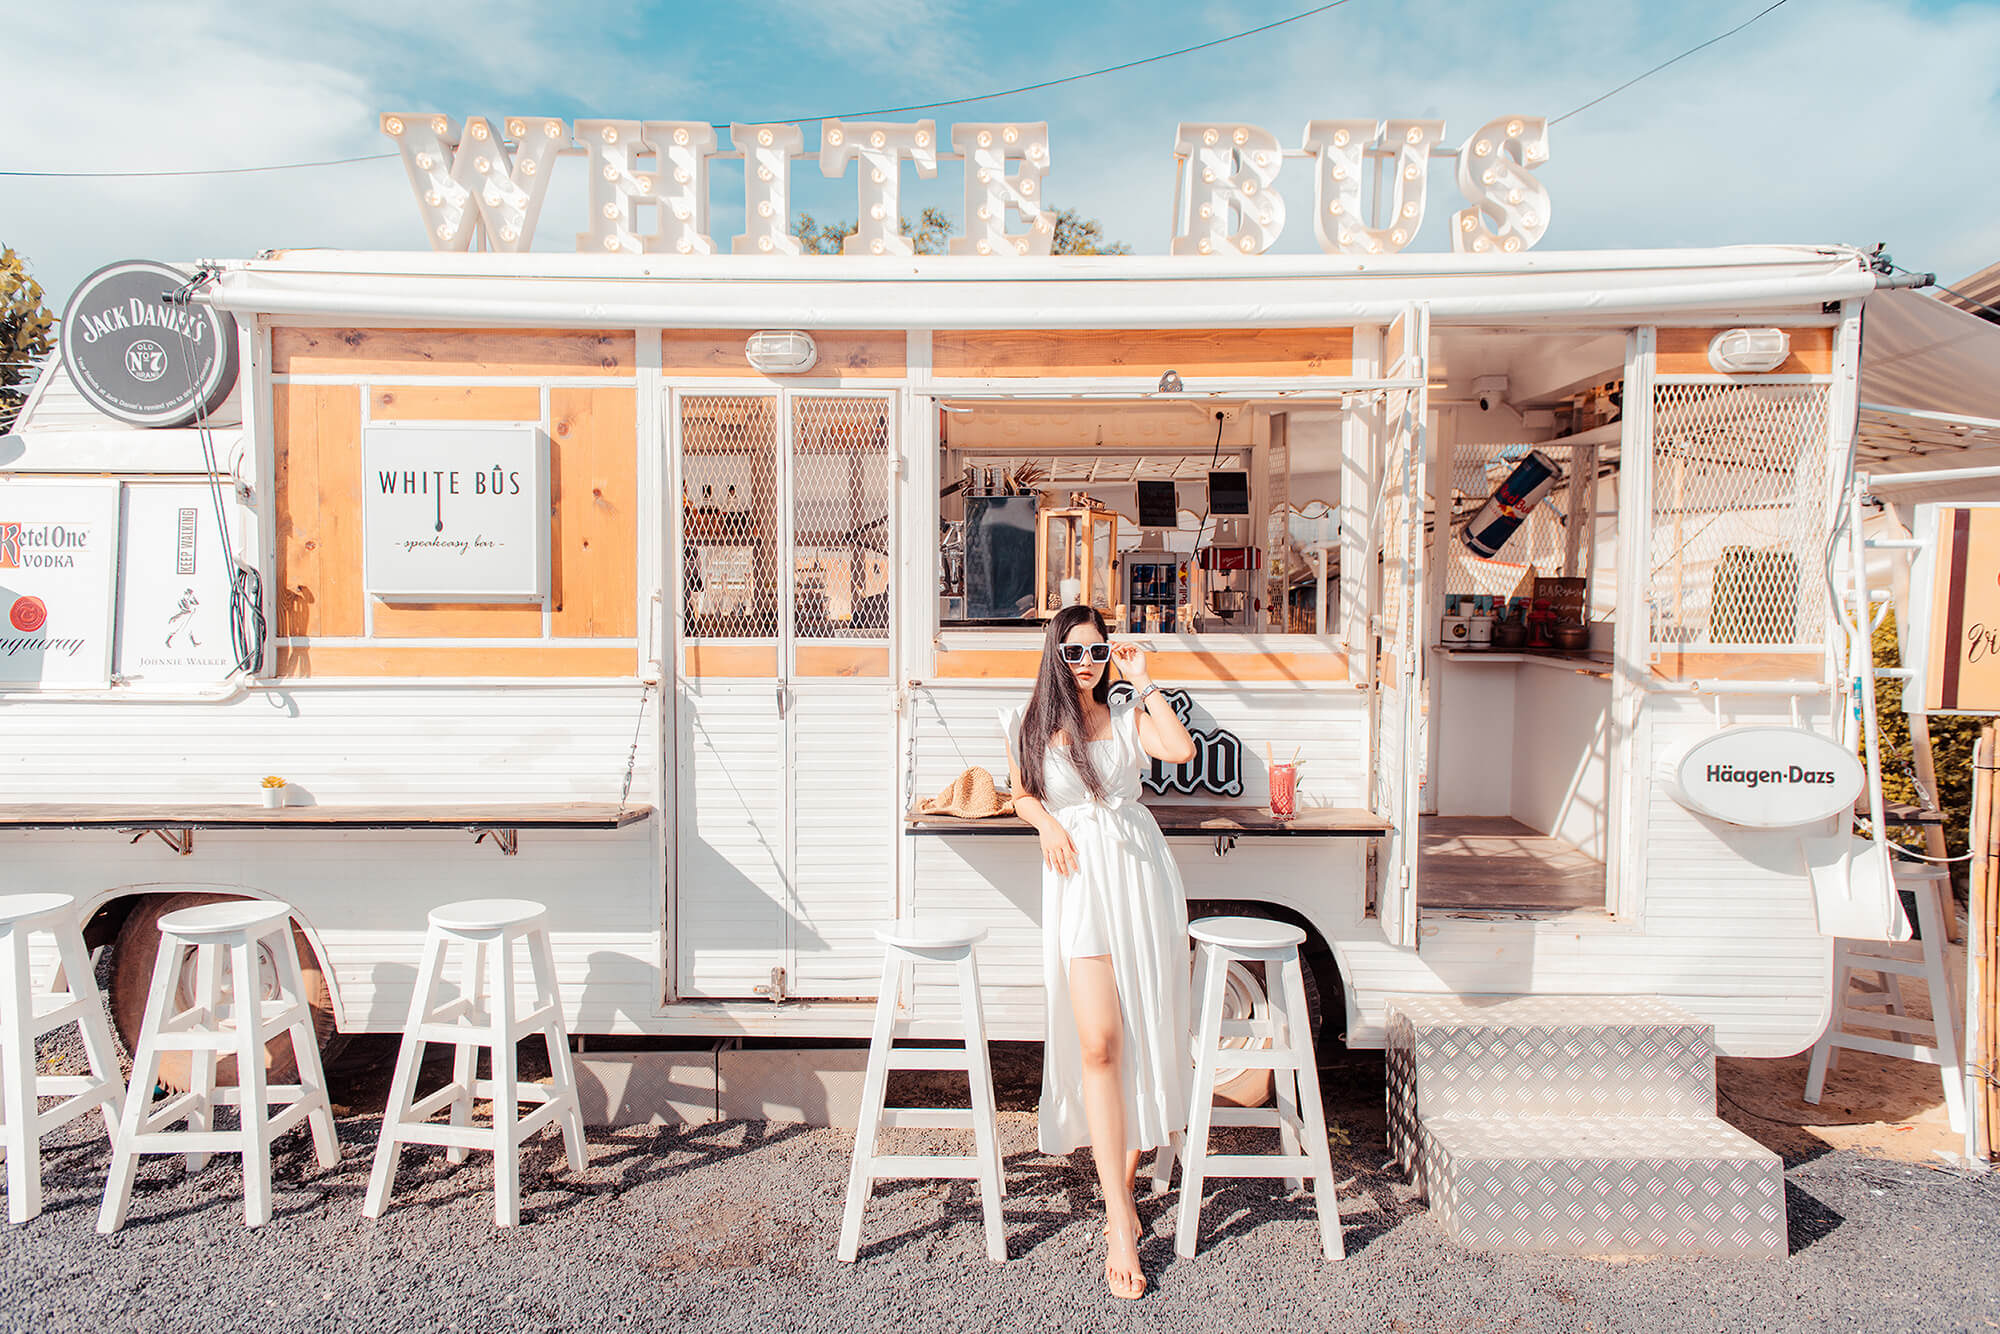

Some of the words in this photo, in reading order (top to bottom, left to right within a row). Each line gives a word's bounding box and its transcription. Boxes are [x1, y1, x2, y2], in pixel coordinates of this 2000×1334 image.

[379, 113, 1056, 256] WHITE
[1171, 114, 1551, 255] BUS
[80, 305, 130, 343] JACK
[181, 510, 194, 549] WALKING
[474, 534, 495, 548] bar
[0, 525, 49, 566] Ketel
[52, 525, 87, 548] One
[23, 554, 75, 568] VODKA
[180, 551, 193, 572] KEEP
[139, 656, 182, 668] JOHNNIE
[186, 656, 227, 666] WALKER
